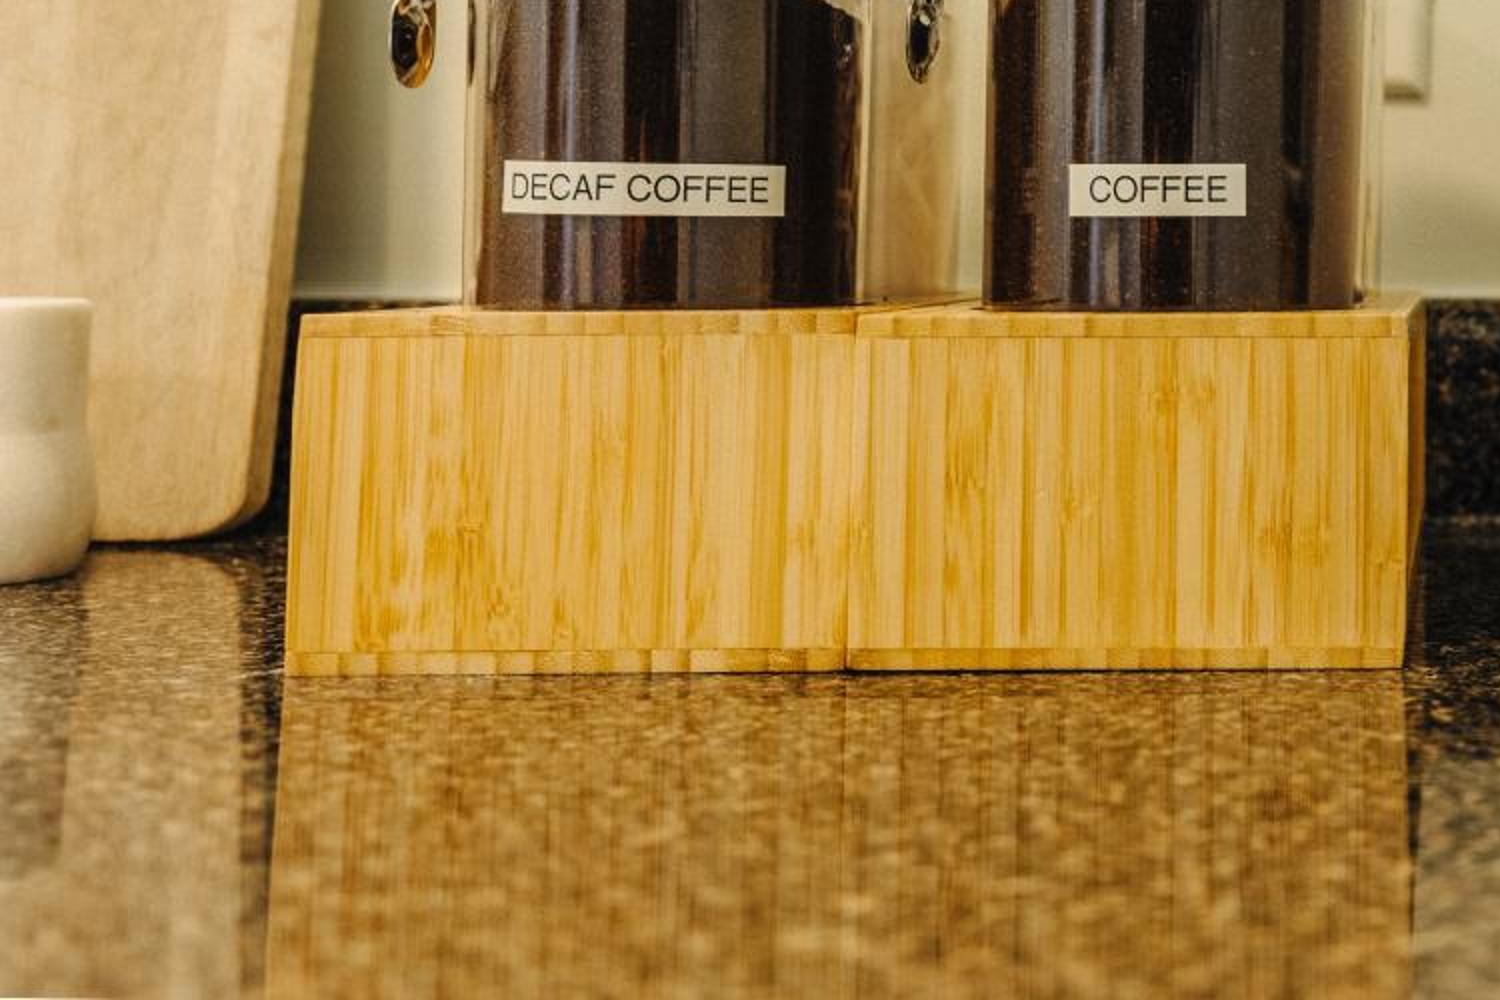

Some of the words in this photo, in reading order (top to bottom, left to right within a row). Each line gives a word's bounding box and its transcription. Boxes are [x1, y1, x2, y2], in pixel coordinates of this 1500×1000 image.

[511, 173, 616, 201] DECAF
[627, 174, 769, 203] COFFEE
[1089, 175, 1228, 203] COFFEE
